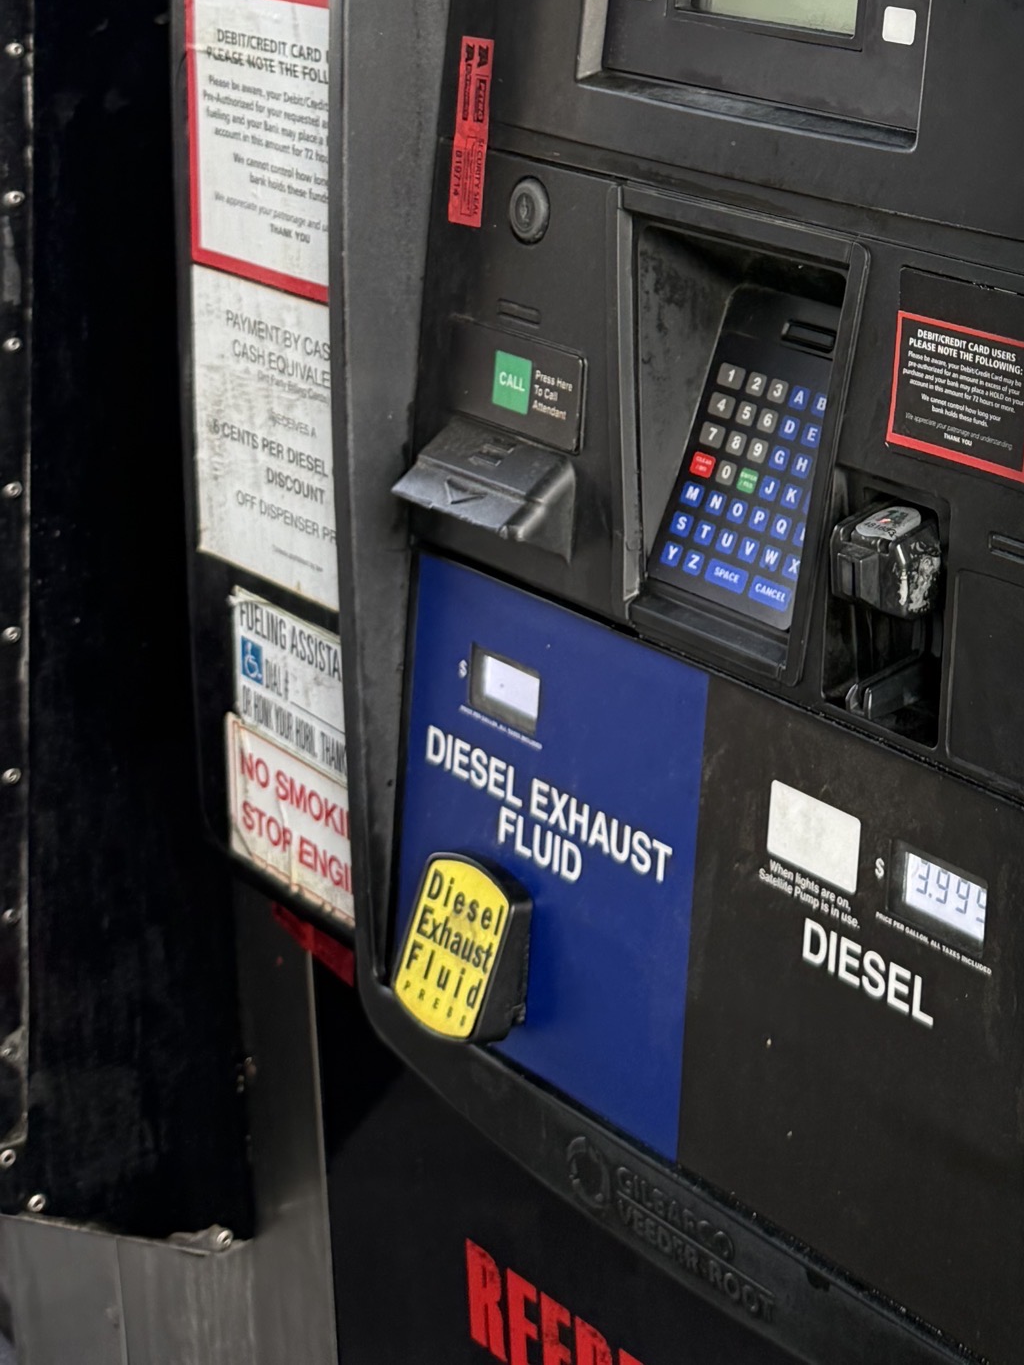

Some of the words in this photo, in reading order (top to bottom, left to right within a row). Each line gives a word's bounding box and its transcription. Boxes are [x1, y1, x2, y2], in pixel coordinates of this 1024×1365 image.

[217, 28, 288, 57] DEBIT/CREDIT
[291, 44, 322, 62] CARD
[247, 54, 276, 73] NOTE
[279, 61, 300, 78] THE
[226, 309, 280, 345] PAYMENT
[283, 330, 301, 351] BY
[917, 329, 967, 349] DEBIT/CREDIT
[968, 342, 990, 354] CARD
[991, 348, 1016, 362] USERS
[233, 339, 266, 367] CASH
[909, 337, 936, 351] PLEASE
[937, 345, 957, 357] NOTE
[960, 351, 973, 362] THE
[975, 355, 1023, 375] FOLLOWING:
[499, 371, 525, 392] CALL
[534, 384, 543, 396] To
[544, 388, 558, 401] Call
[535, 370, 555, 385] Press
[556, 378, 573, 392] Here
[728, 369, 735, 382] 1
[752, 377, 762, 391] 2
[773, 384, 783, 397] 3
[532, 400, 567, 420] Attendant
[717, 399, 727, 411] 4
[741, 406, 752, 420] 5
[763, 413, 773, 427] 6
[222, 422, 259, 449] CENTS
[261, 438, 284, 459] PER
[287, 447, 329, 478] DIESEL
[708, 427, 718, 440] 7
[731, 436, 741, 449] 8
[753, 443, 763, 456] 9
[266, 467, 325, 505] DISCOUNT
[721, 465, 731, 479] 0
[236, 490, 257, 510] OFF
[259, 499, 320, 538] DISPENSER
[714, 566, 740, 584] SPACE
[755, 582, 785, 603] CANCEL
[240, 601, 287, 650] FUELING
[458, 659, 467, 680] $
[240, 748, 269, 788] NO
[424, 725, 522, 808] DIESEL
[529, 777, 673, 884] EXHAUST
[242, 800, 293, 853] STOP
[298, 835, 352, 894] ENGI
[498, 806, 583, 884] FLUID
[769, 859, 794, 880] When
[795, 872, 820, 895] lights
[821, 886, 836, 903] are
[837, 893, 851, 911] on,
[875, 857, 885, 880] $
[427, 868, 504, 936] Diesel
[758, 868, 793, 894] Satellite
[794, 887, 820, 911] Pump
[821, 901, 829, 912] is
[830, 905, 839, 917] in
[841, 911, 861, 929] use.
[416, 904, 493, 975] Exhaust
[405, 939, 483, 1009] Fluid
[802, 917, 934, 1028] DIESEL
